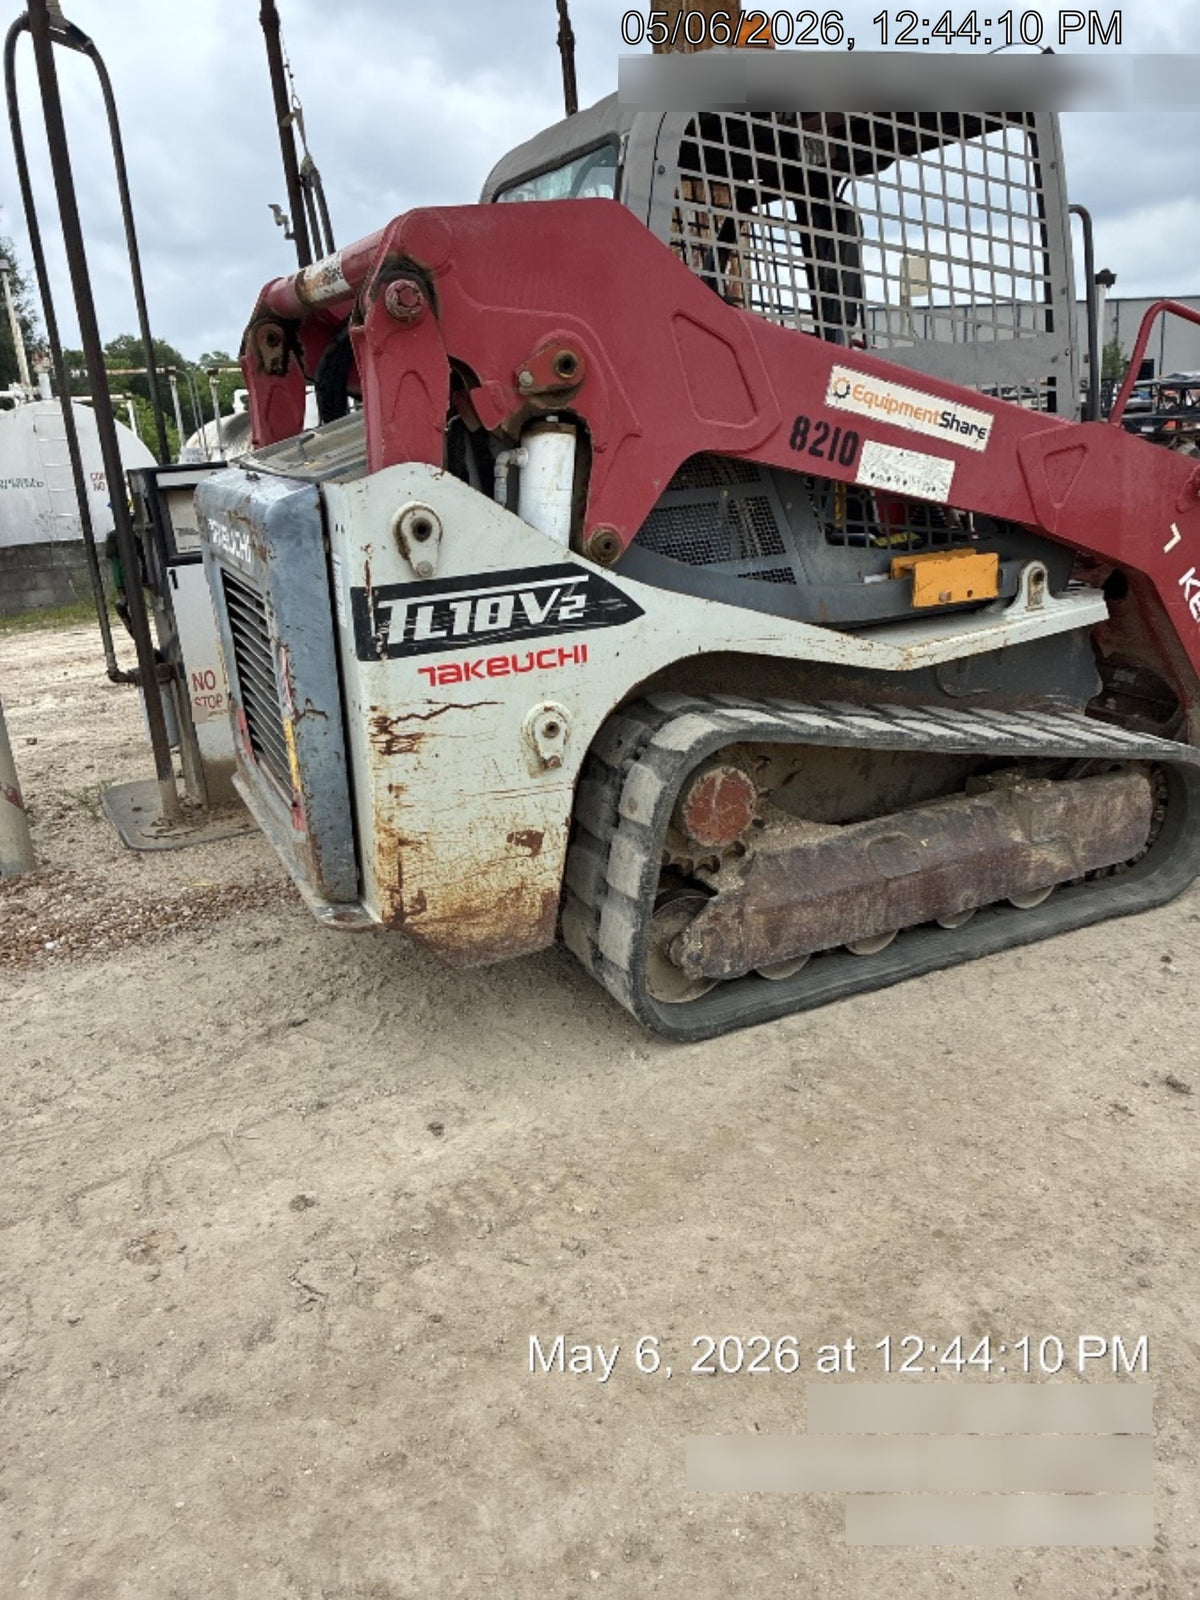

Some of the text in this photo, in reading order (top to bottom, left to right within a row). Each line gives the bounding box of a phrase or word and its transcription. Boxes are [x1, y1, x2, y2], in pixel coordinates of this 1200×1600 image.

[852, 383, 988, 440] EquipmentShare
[789, 415, 860, 467] 8210
[168, 568, 179, 590] 1
[377, 574, 589, 645] TL10V2
[191, 669, 216, 692] NO
[417, 644, 588, 686] TAKEUCHI
